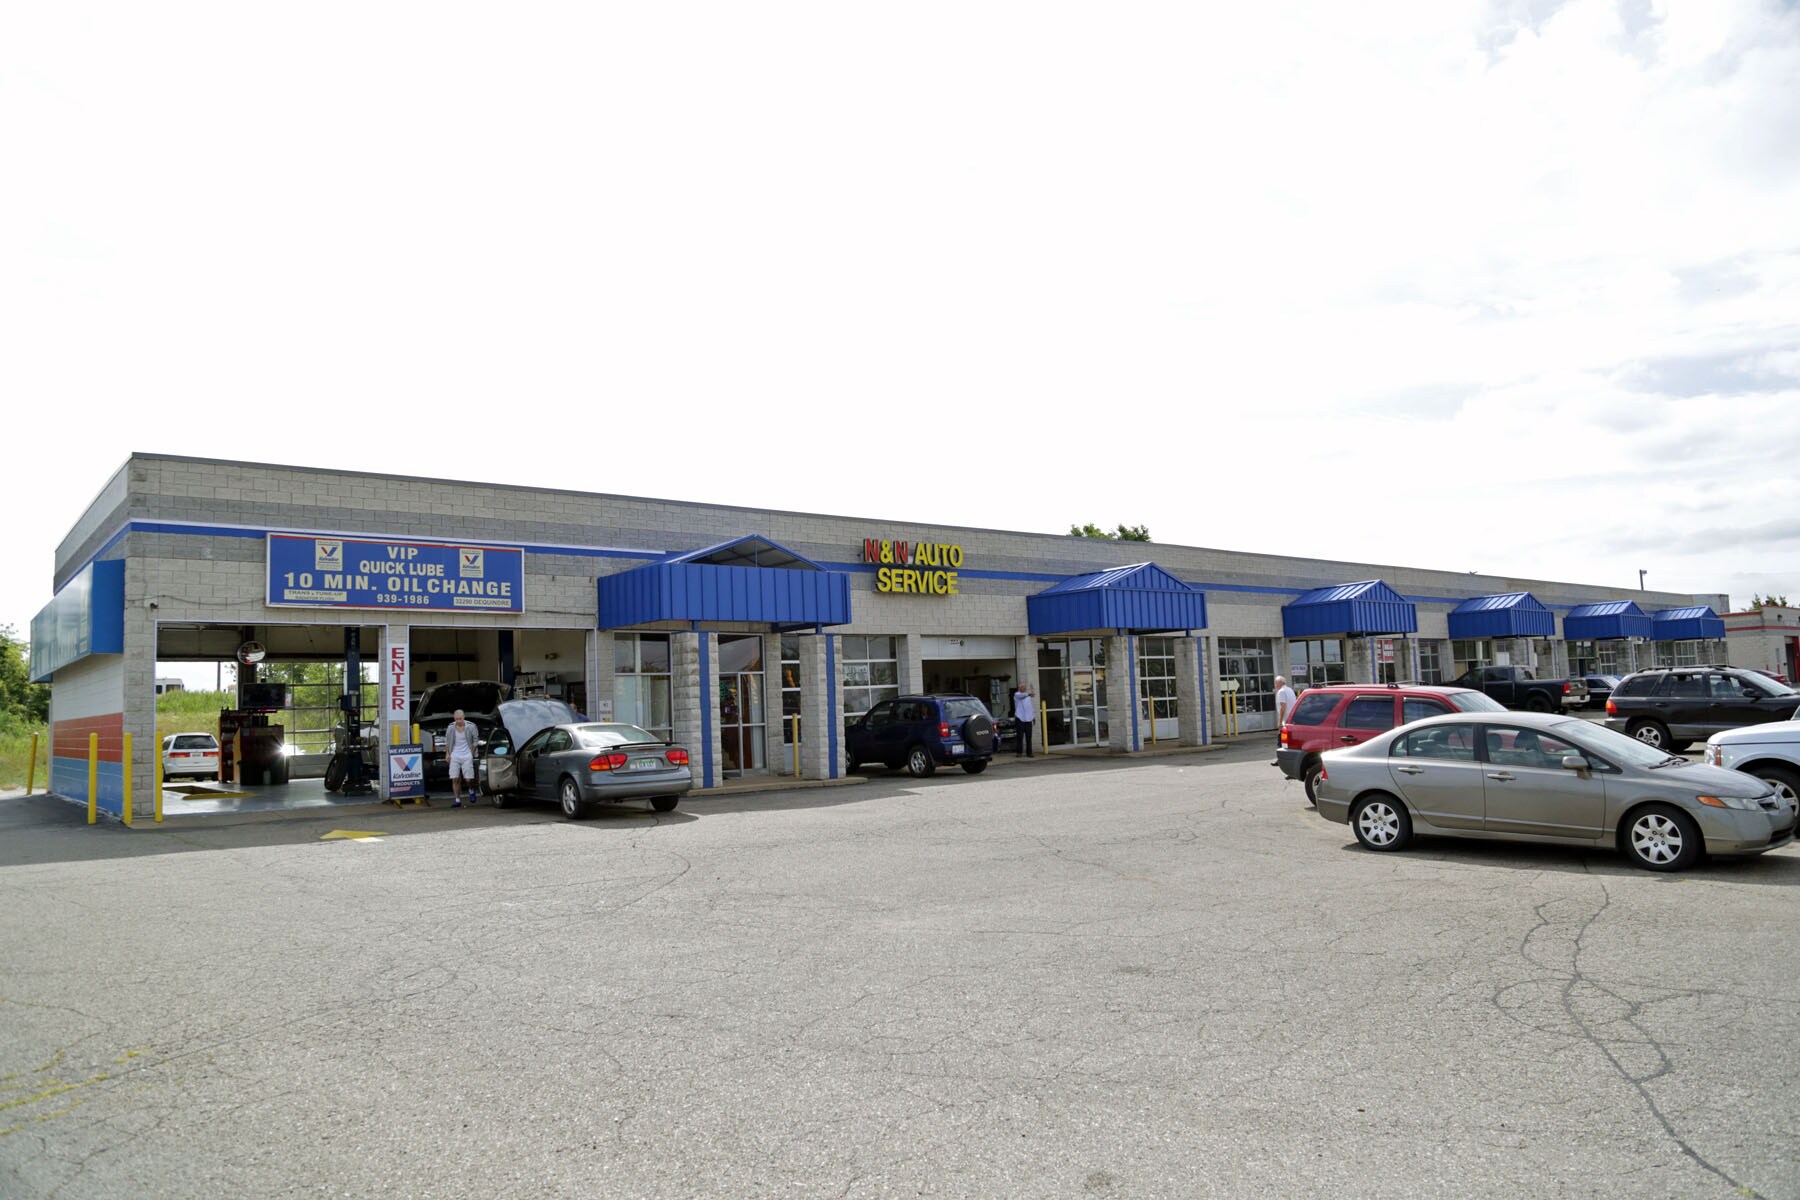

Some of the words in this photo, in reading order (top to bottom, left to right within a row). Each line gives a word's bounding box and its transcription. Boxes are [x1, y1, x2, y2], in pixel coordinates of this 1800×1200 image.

[387, 546, 418, 560] VIP
[864, 538, 909, 564] N&N
[915, 542, 964, 568] AUTO
[360, 560, 405, 575] QUICK
[409, 562, 445, 577] LUBE
[877, 567, 959, 594] SERVICE
[284, 572, 314, 588] 10
[324, 574, 377, 591] MIN.
[387, 576, 423, 593] OIL
[427, 578, 511, 596] CHANGE
[376, 593, 430, 605] 939-1986
[391, 647, 405, 710] ENTER
